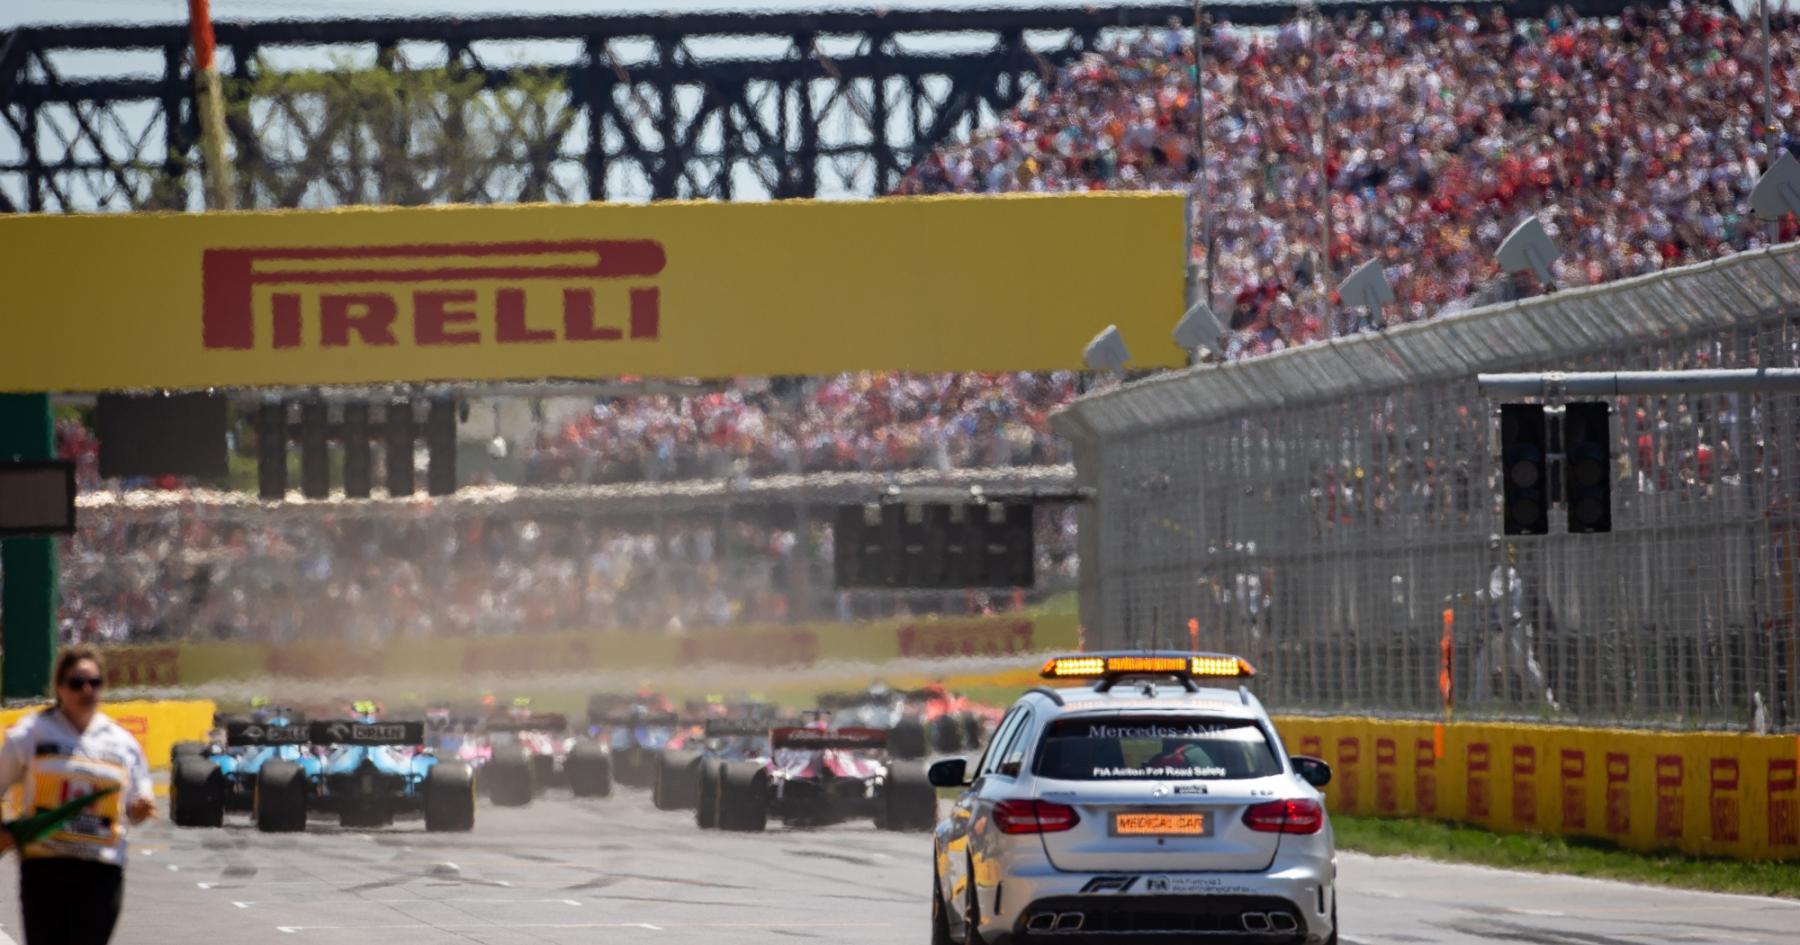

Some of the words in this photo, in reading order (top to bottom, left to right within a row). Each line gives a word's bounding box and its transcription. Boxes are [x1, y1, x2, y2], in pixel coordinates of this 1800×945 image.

[202, 239, 667, 349] PIRELLI
[1093, 767, 1111, 776] FIA
[1146, 767, 1164, 776] For
[1165, 766, 1192, 777] Road
[1194, 766, 1227, 777] Safety
[1119, 817, 1173, 829] MEDICAL
[1146, 878, 1167, 891] FIA
